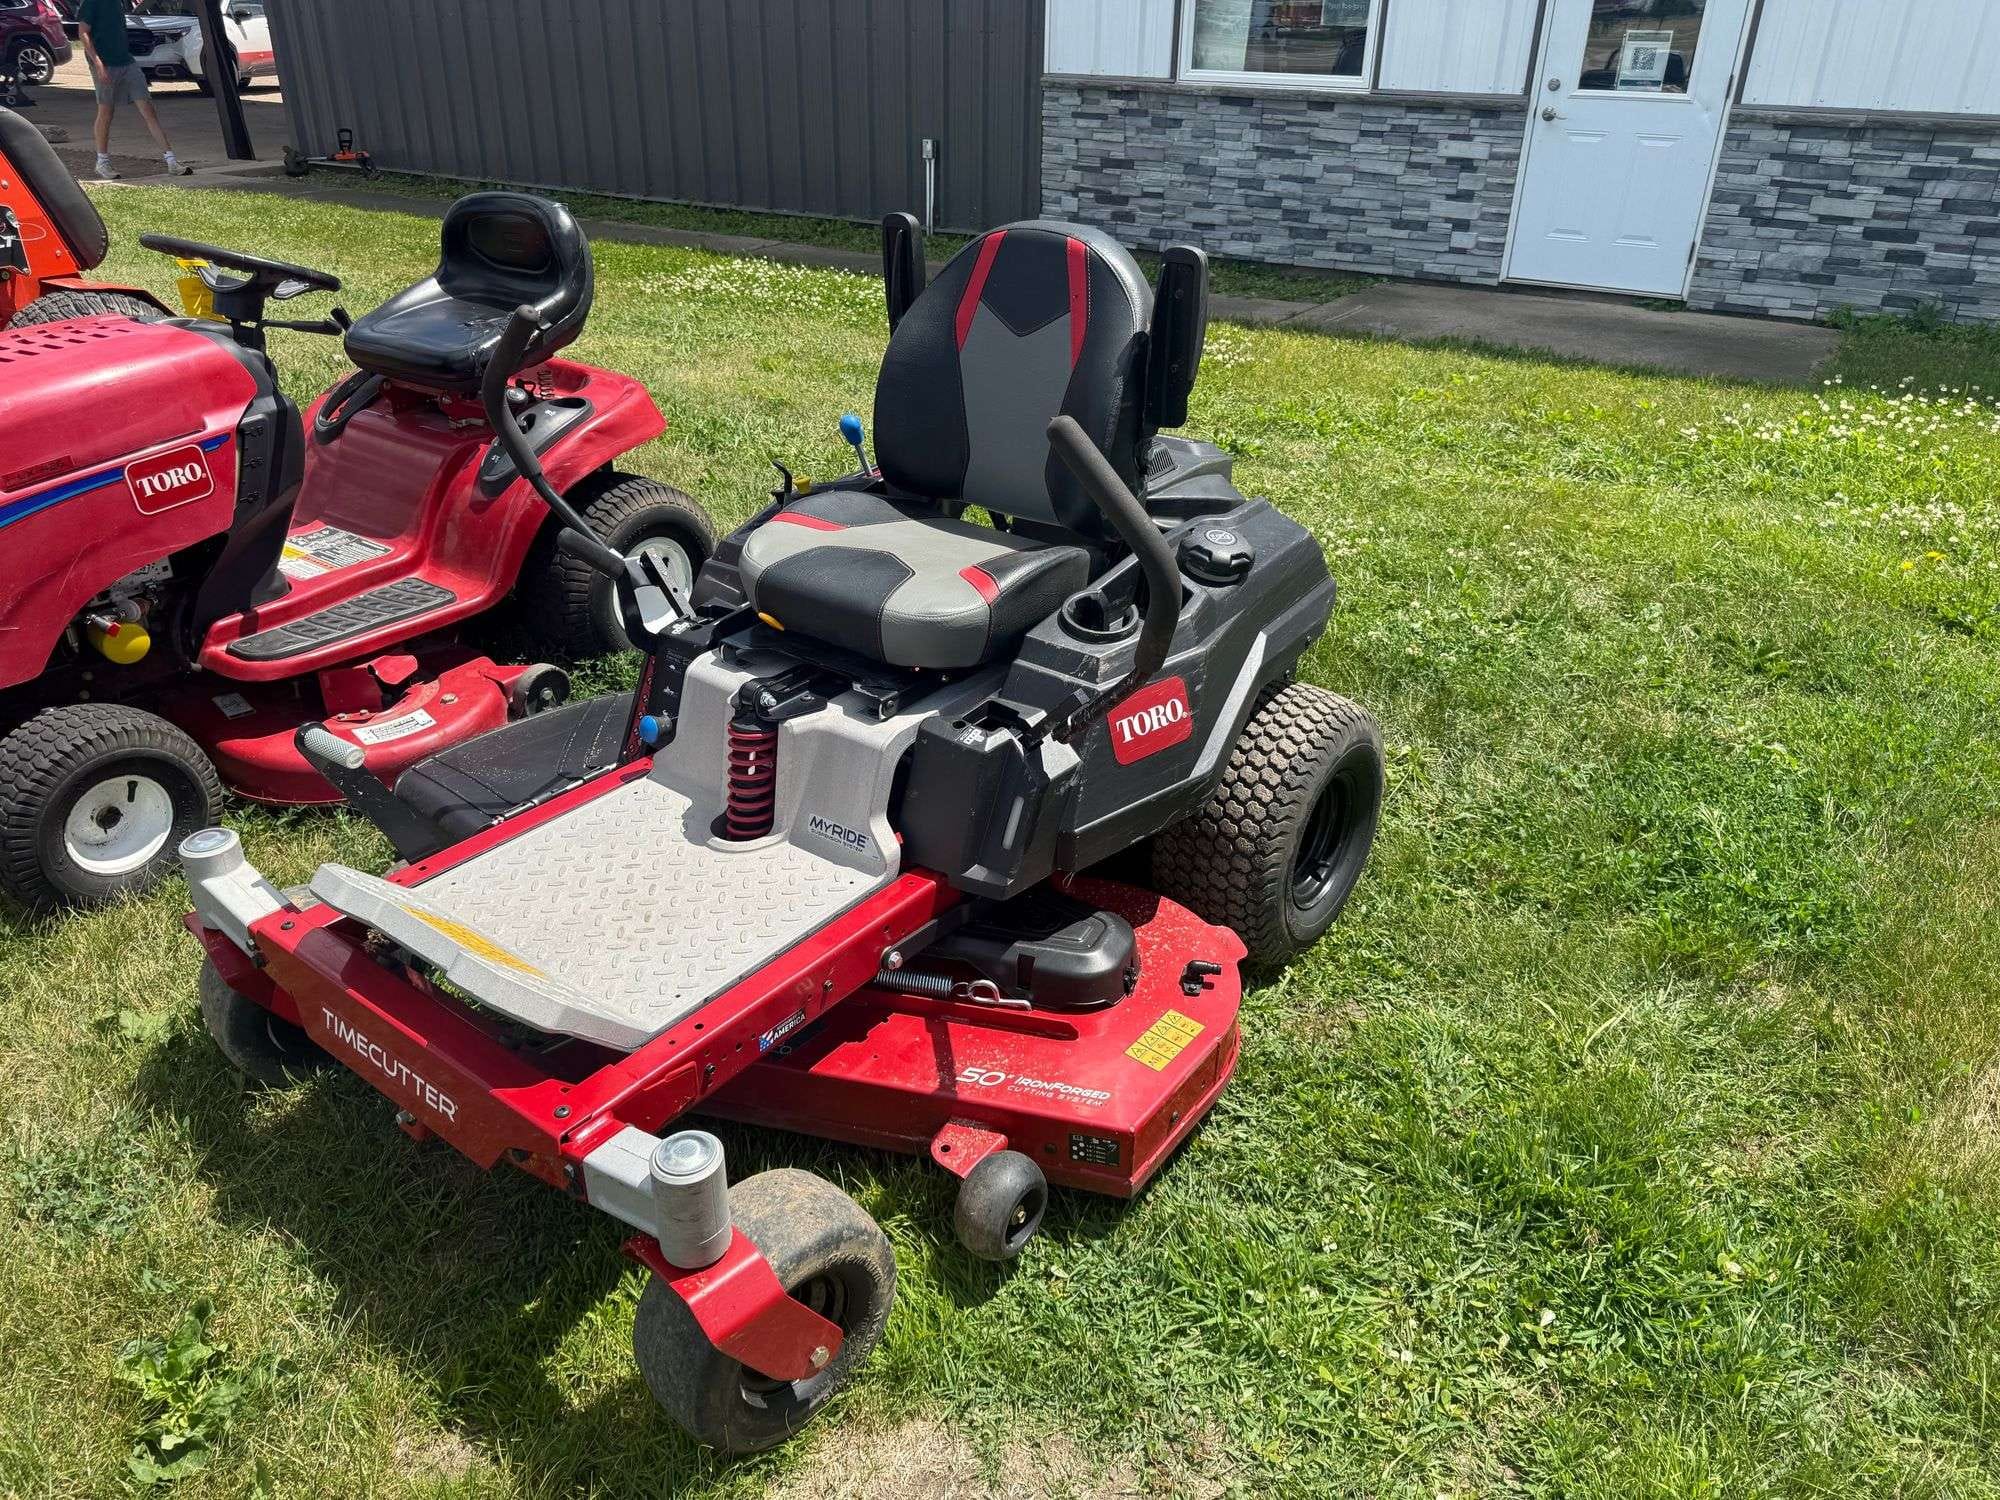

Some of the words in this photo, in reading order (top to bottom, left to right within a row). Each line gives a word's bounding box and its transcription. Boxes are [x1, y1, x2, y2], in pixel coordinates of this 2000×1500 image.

[136, 462, 203, 498] TORO
[1116, 698, 1184, 743] TORO
[774, 1013, 806, 1040] AMERICA
[322, 1007, 457, 1122] TIMECUTTER
[1007, 1085, 1054, 1098] CUTTING
[1056, 1093, 1104, 1107] SYSTEM
